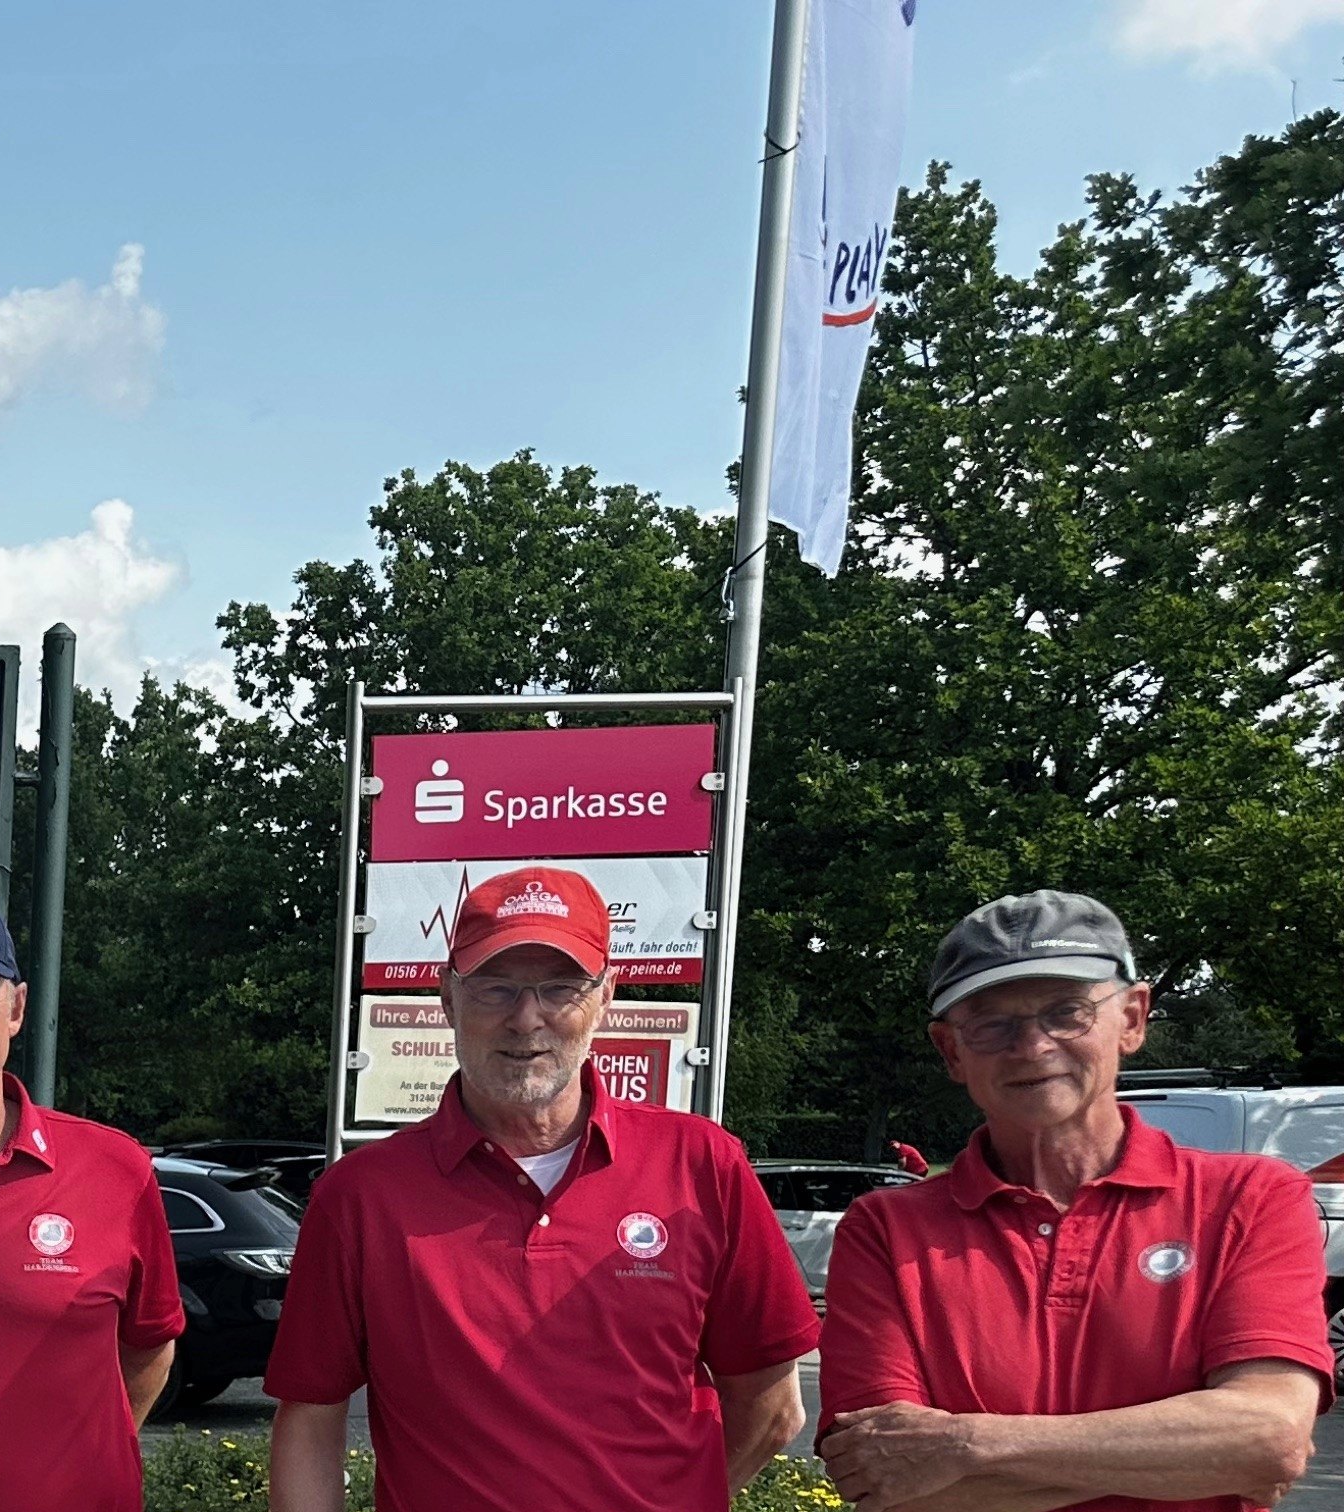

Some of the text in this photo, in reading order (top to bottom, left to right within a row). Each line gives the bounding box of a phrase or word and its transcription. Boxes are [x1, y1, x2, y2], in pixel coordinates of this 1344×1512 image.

[829, 222, 888, 306] PLAY
[483, 786, 668, 829] Sparkasse
[504, 892, 563, 906] OMEGA
[639, 941, 663, 953] fahr
[665, 940, 698, 953] doch!
[384, 965, 418, 979] 01516
[375, 1008, 449, 1025] Ihre Adr
[606, 1012, 683, 1030] Wohnen!
[391, 1040, 455, 1057] SCHULE
